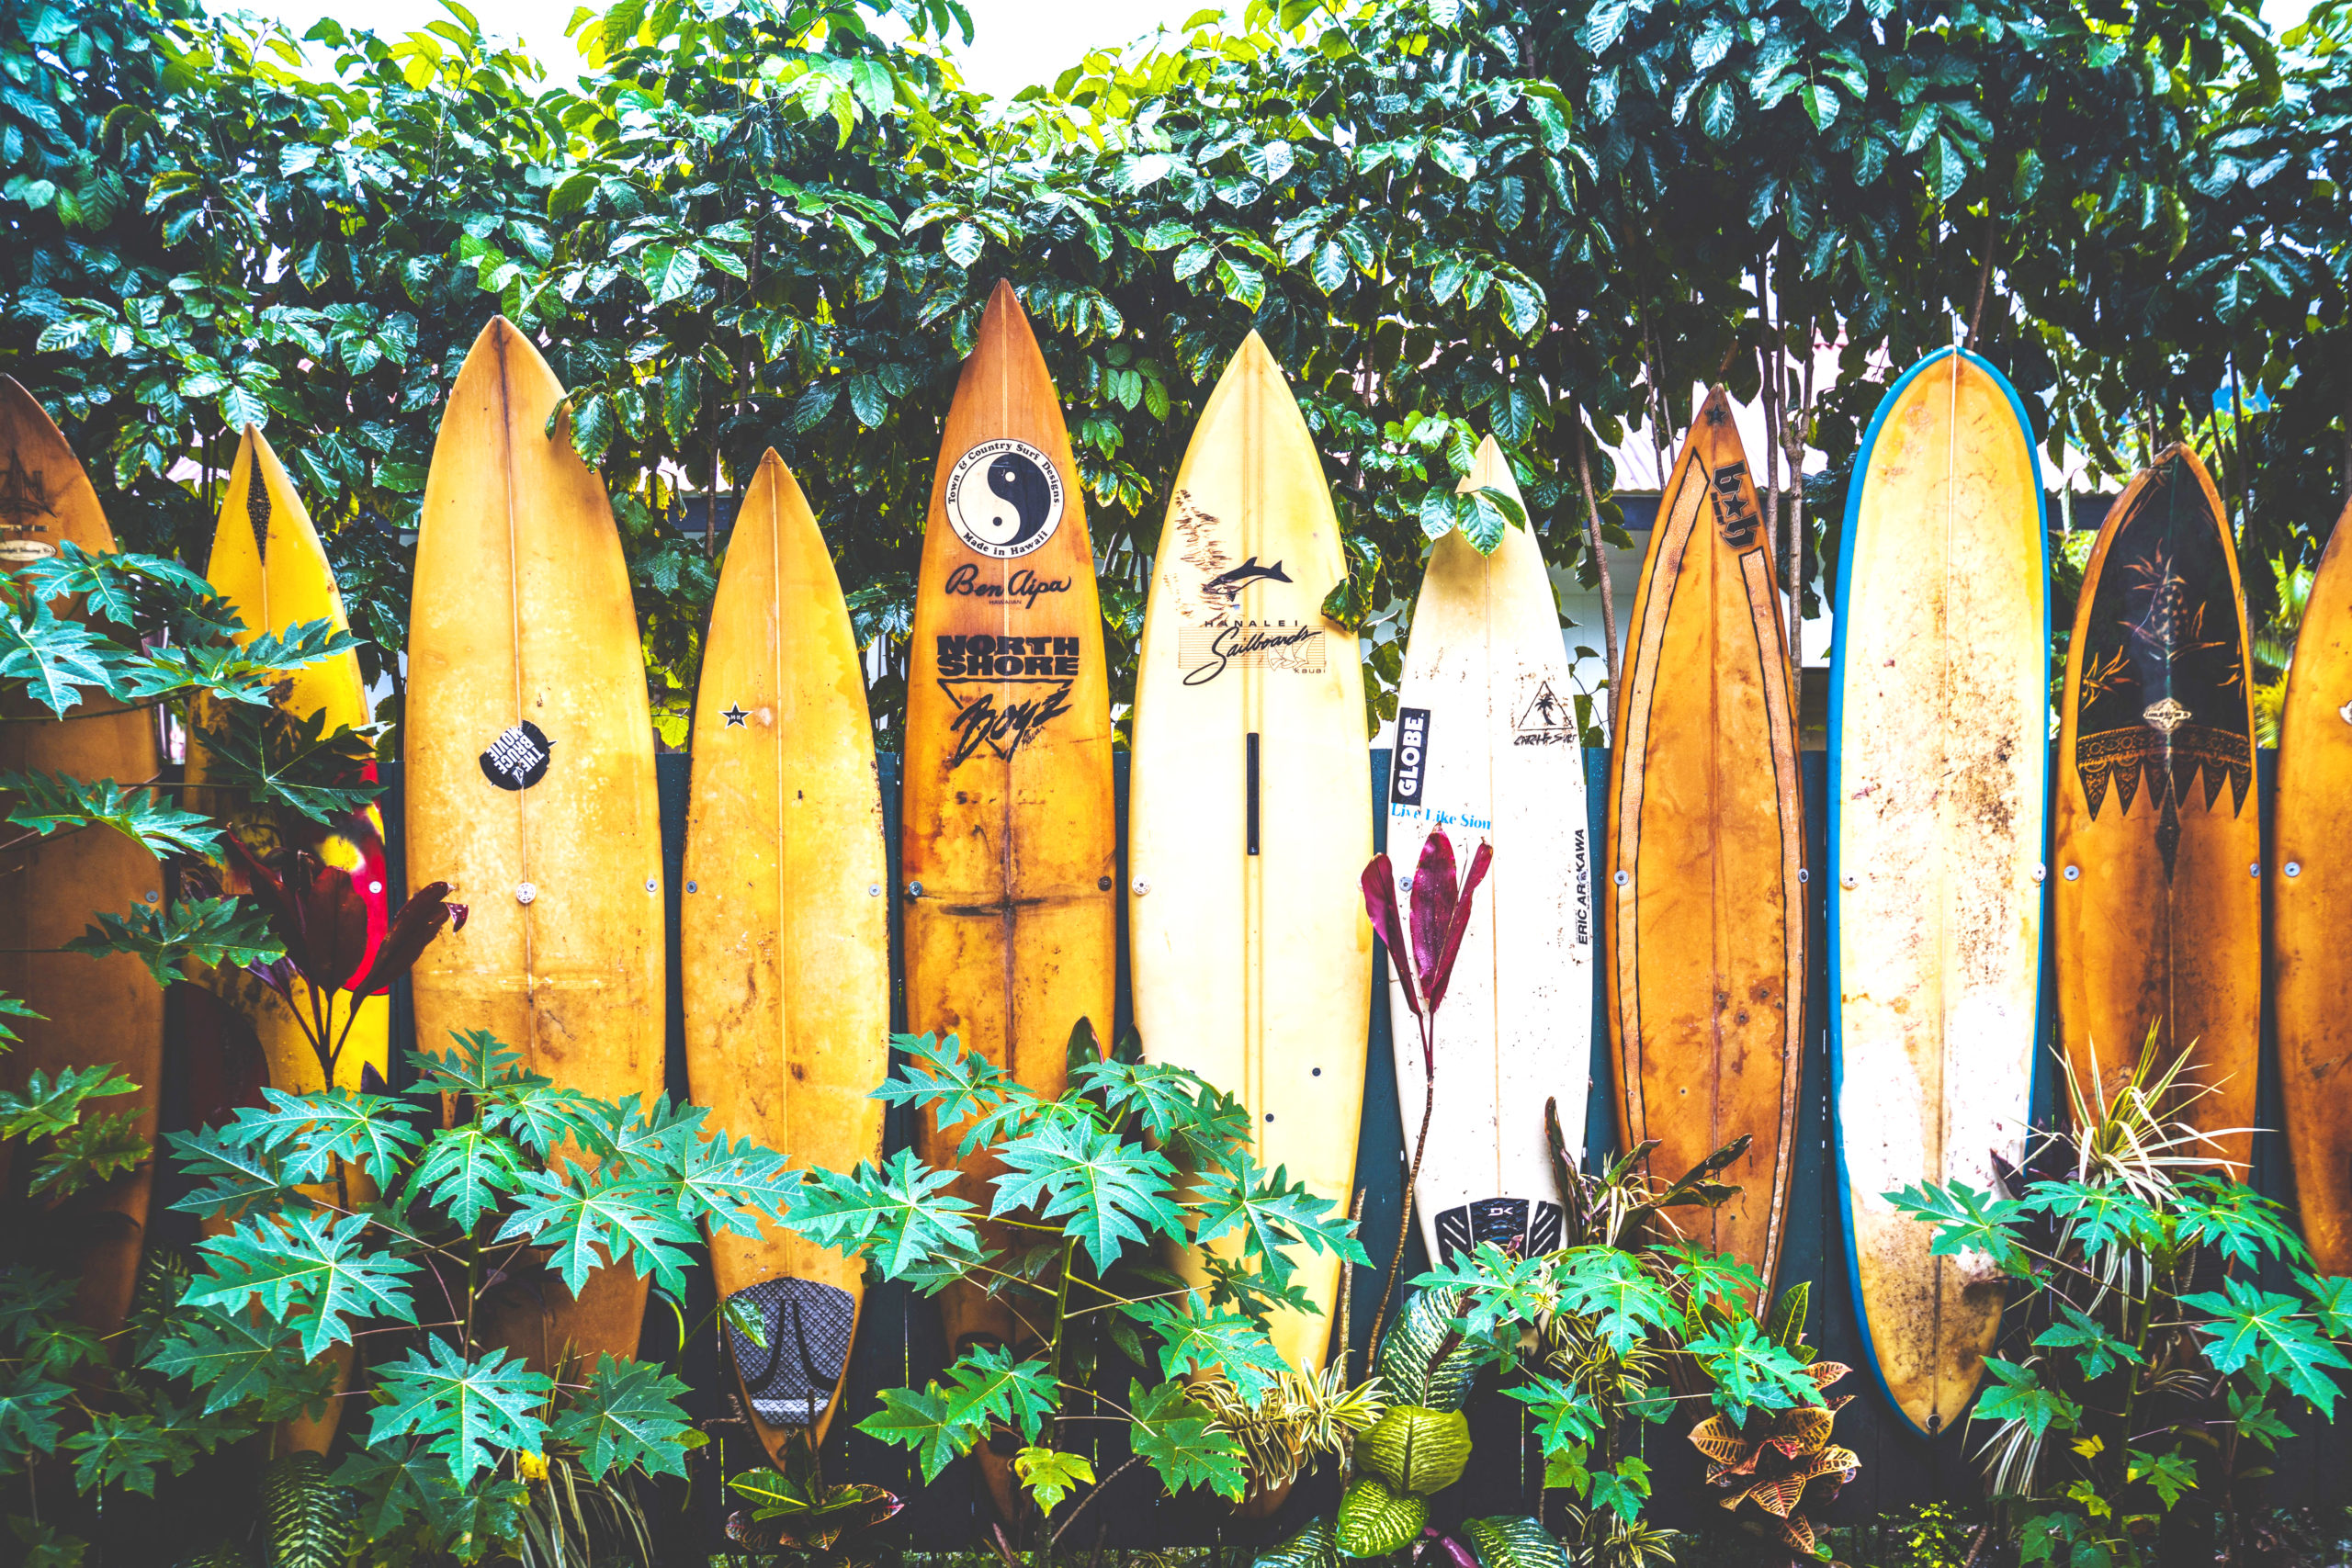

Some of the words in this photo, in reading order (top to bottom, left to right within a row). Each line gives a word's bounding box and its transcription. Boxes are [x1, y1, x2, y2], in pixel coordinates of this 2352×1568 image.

[948, 474, 960, 504] Town
[958, 460, 967, 470] &
[967, 443, 1012, 460] Country
[1016, 444, 1041, 460] Surf
[1041, 461, 1059, 503] Designs
[963, 532, 989, 552] Made
[993, 547, 1005, 556] in
[1011, 530, 1048, 555] Hawaii
[944, 563, 1004, 597] Ben
[1008, 570, 1072, 609] Aipa
[936, 635, 1080, 656] NORTH
[1182, 625, 1322, 685] Sailboards
[936, 655, 1080, 676] SHORE
[485, 727, 524, 761] MOVIE
[950, 688, 1073, 768] Boyz
[493, 735, 535, 775] BRUCE
[518, 746, 546, 773] THE
[1391, 802, 1421, 819] Live
[1426, 808, 1456, 825] Like
[1460, 814, 1491, 829] Sion
[1575, 829, 1587, 907] ARKAWA
[1577, 908, 1588, 945] ERIC
